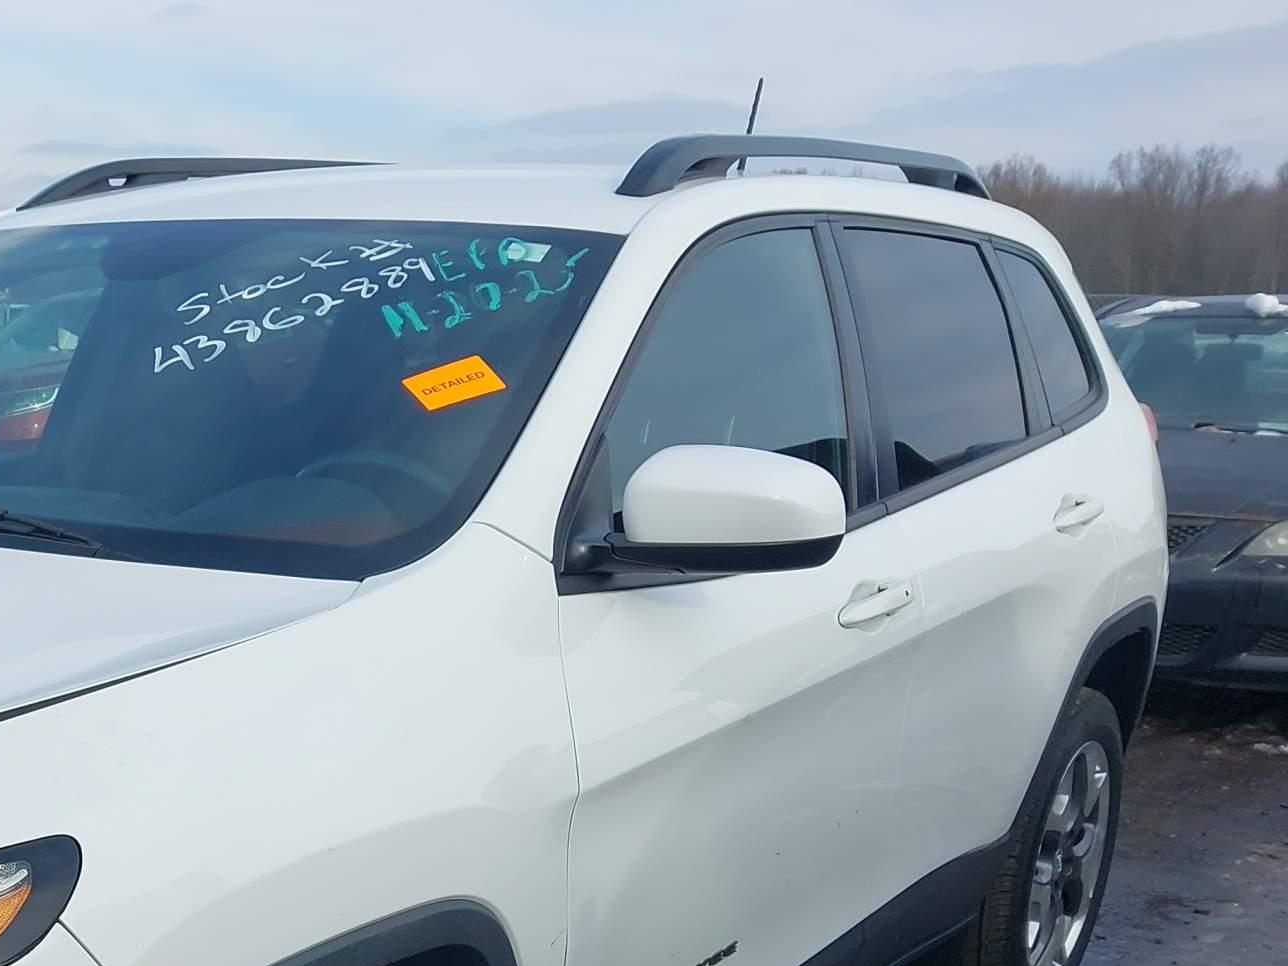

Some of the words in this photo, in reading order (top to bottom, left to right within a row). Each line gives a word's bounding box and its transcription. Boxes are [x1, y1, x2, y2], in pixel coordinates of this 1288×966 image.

[153, 256, 436, 374] 43862889
[176, 250, 350, 325] Stock
[421, 371, 485, 396] DETAILED
